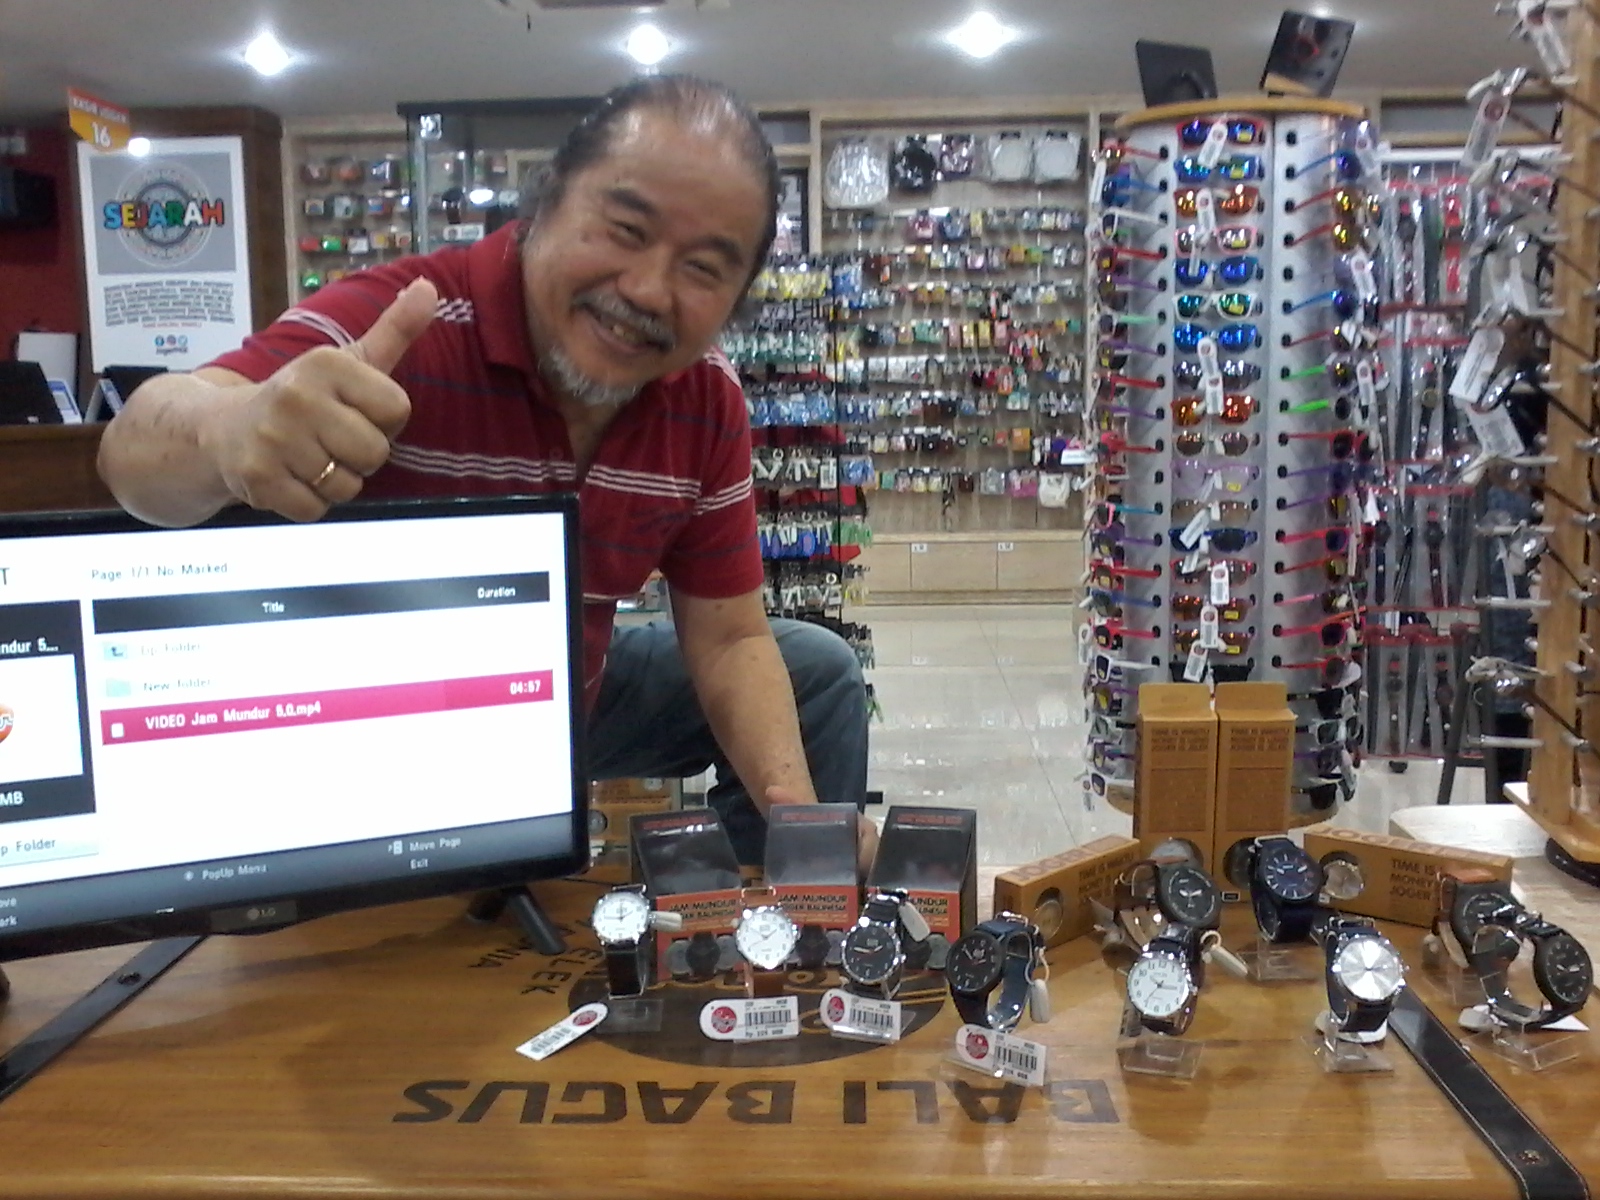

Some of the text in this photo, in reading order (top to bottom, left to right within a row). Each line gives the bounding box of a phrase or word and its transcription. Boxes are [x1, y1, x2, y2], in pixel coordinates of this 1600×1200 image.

[91, 121, 111, 148] 16
[103, 198, 225, 229] SEJARAH
[92, 563, 228, 582] Page 1/1 No Marked
[262, 587, 516, 613] Title Duration
[144, 681, 170, 692] New
[145, 714, 186, 730] VIDEO
[191, 712, 218, 726] Jam
[223, 706, 271, 723] Mundur
[16, 838, 56, 852] Folder
[409, 840, 435, 852] Move
[439, 836, 461, 848] Page
[202, 863, 267, 881] PopUp Menu
[410, 858, 428, 870] Exit
[1391, 857, 1420, 874] TIME
[669, 899, 737, 912] JAM MUNDUR
[778, 894, 848, 903] JAM MUNDUR
[910, 898, 948, 906] UNDUR
[392, 1080, 1121, 1124] BALI BAGUS
